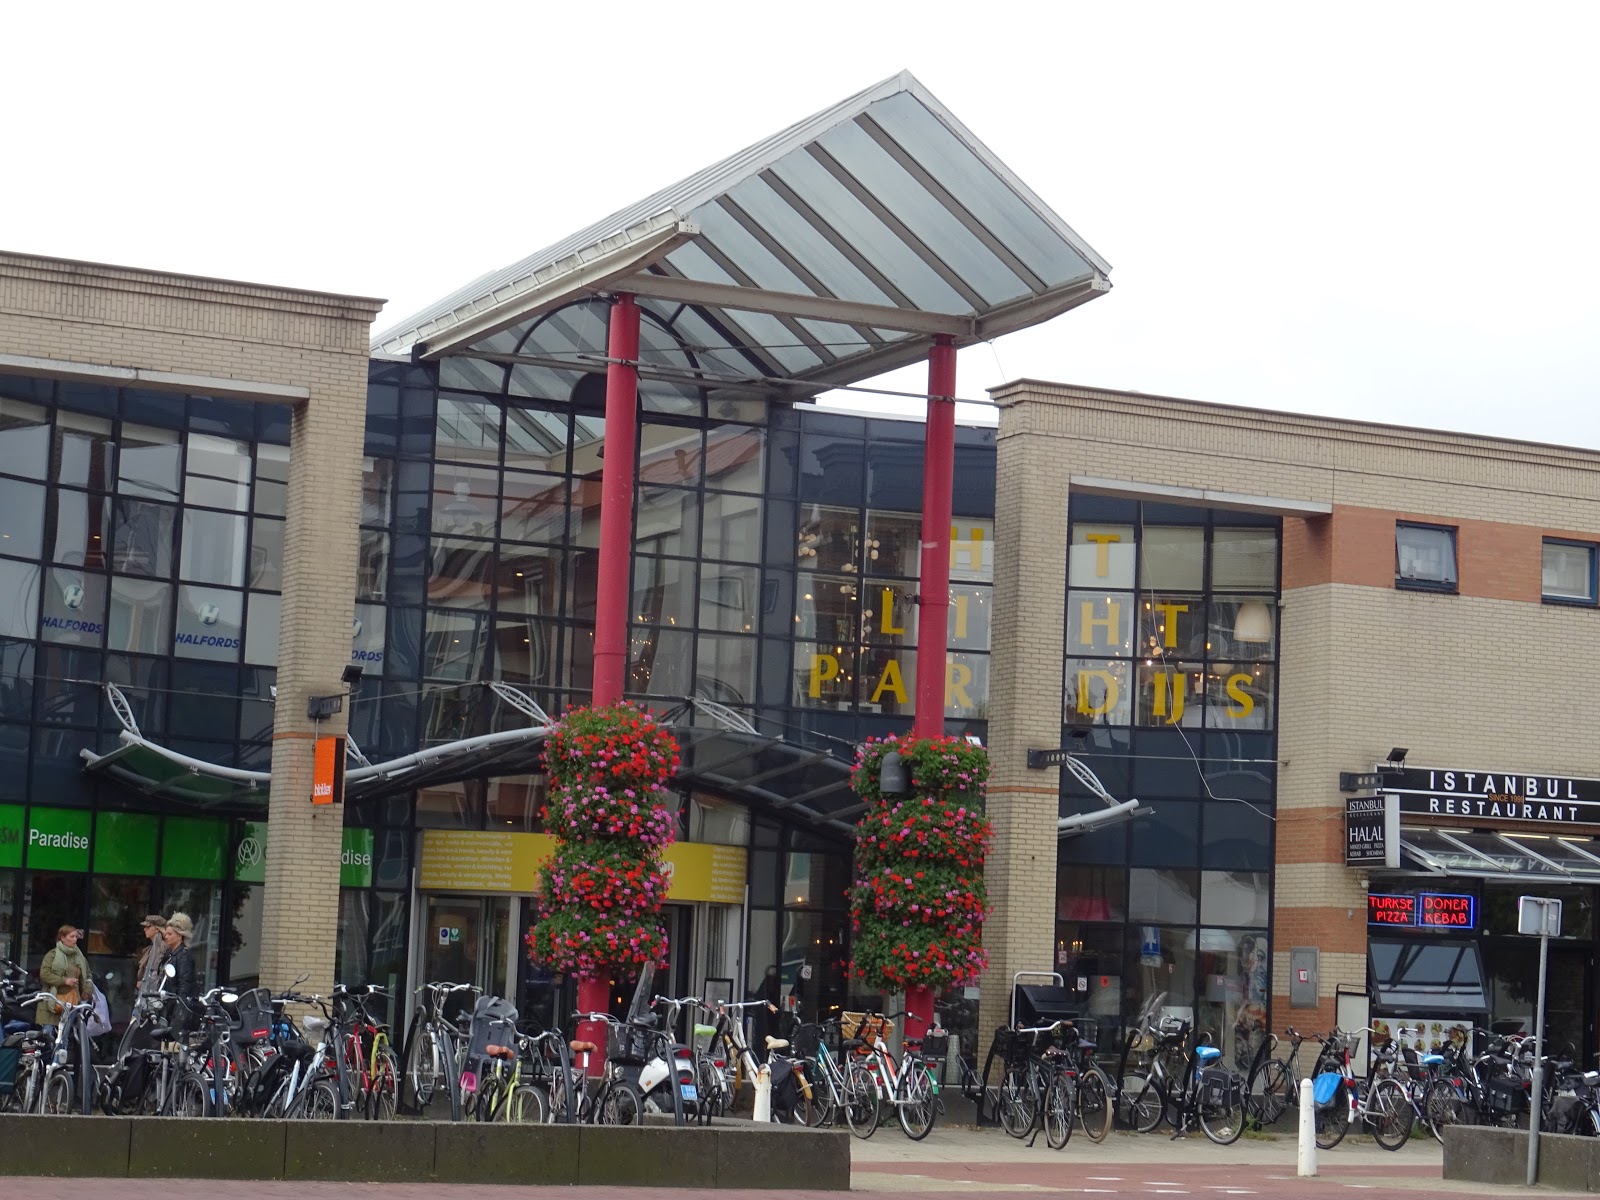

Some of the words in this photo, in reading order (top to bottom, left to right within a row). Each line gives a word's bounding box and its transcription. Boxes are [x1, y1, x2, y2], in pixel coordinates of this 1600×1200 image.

[42, 616, 103, 634] HALFORDS
[175, 632, 241, 648] HALFORDS
[352, 649, 383, 661] ORDS
[808, 653, 1255, 724] PARDIJS
[1430, 771, 1578, 799] ISTANBUL
[1349, 799, 1384, 811] ISTANBUL
[1488, 793, 1508, 803] SINCE
[1430, 798, 1578, 821] RESTAURANT
[0, 825, 19, 844] SM
[29, 828, 89, 850] Paradise
[1349, 825, 1384, 842] HALAL
[341, 849, 371, 866] dise
[1369, 896, 1414, 911] TURKSE
[1424, 897, 1469, 911] DONER
[1376, 911, 1409, 923] PIZZA
[1424, 912, 1467, 924] KEBAB
